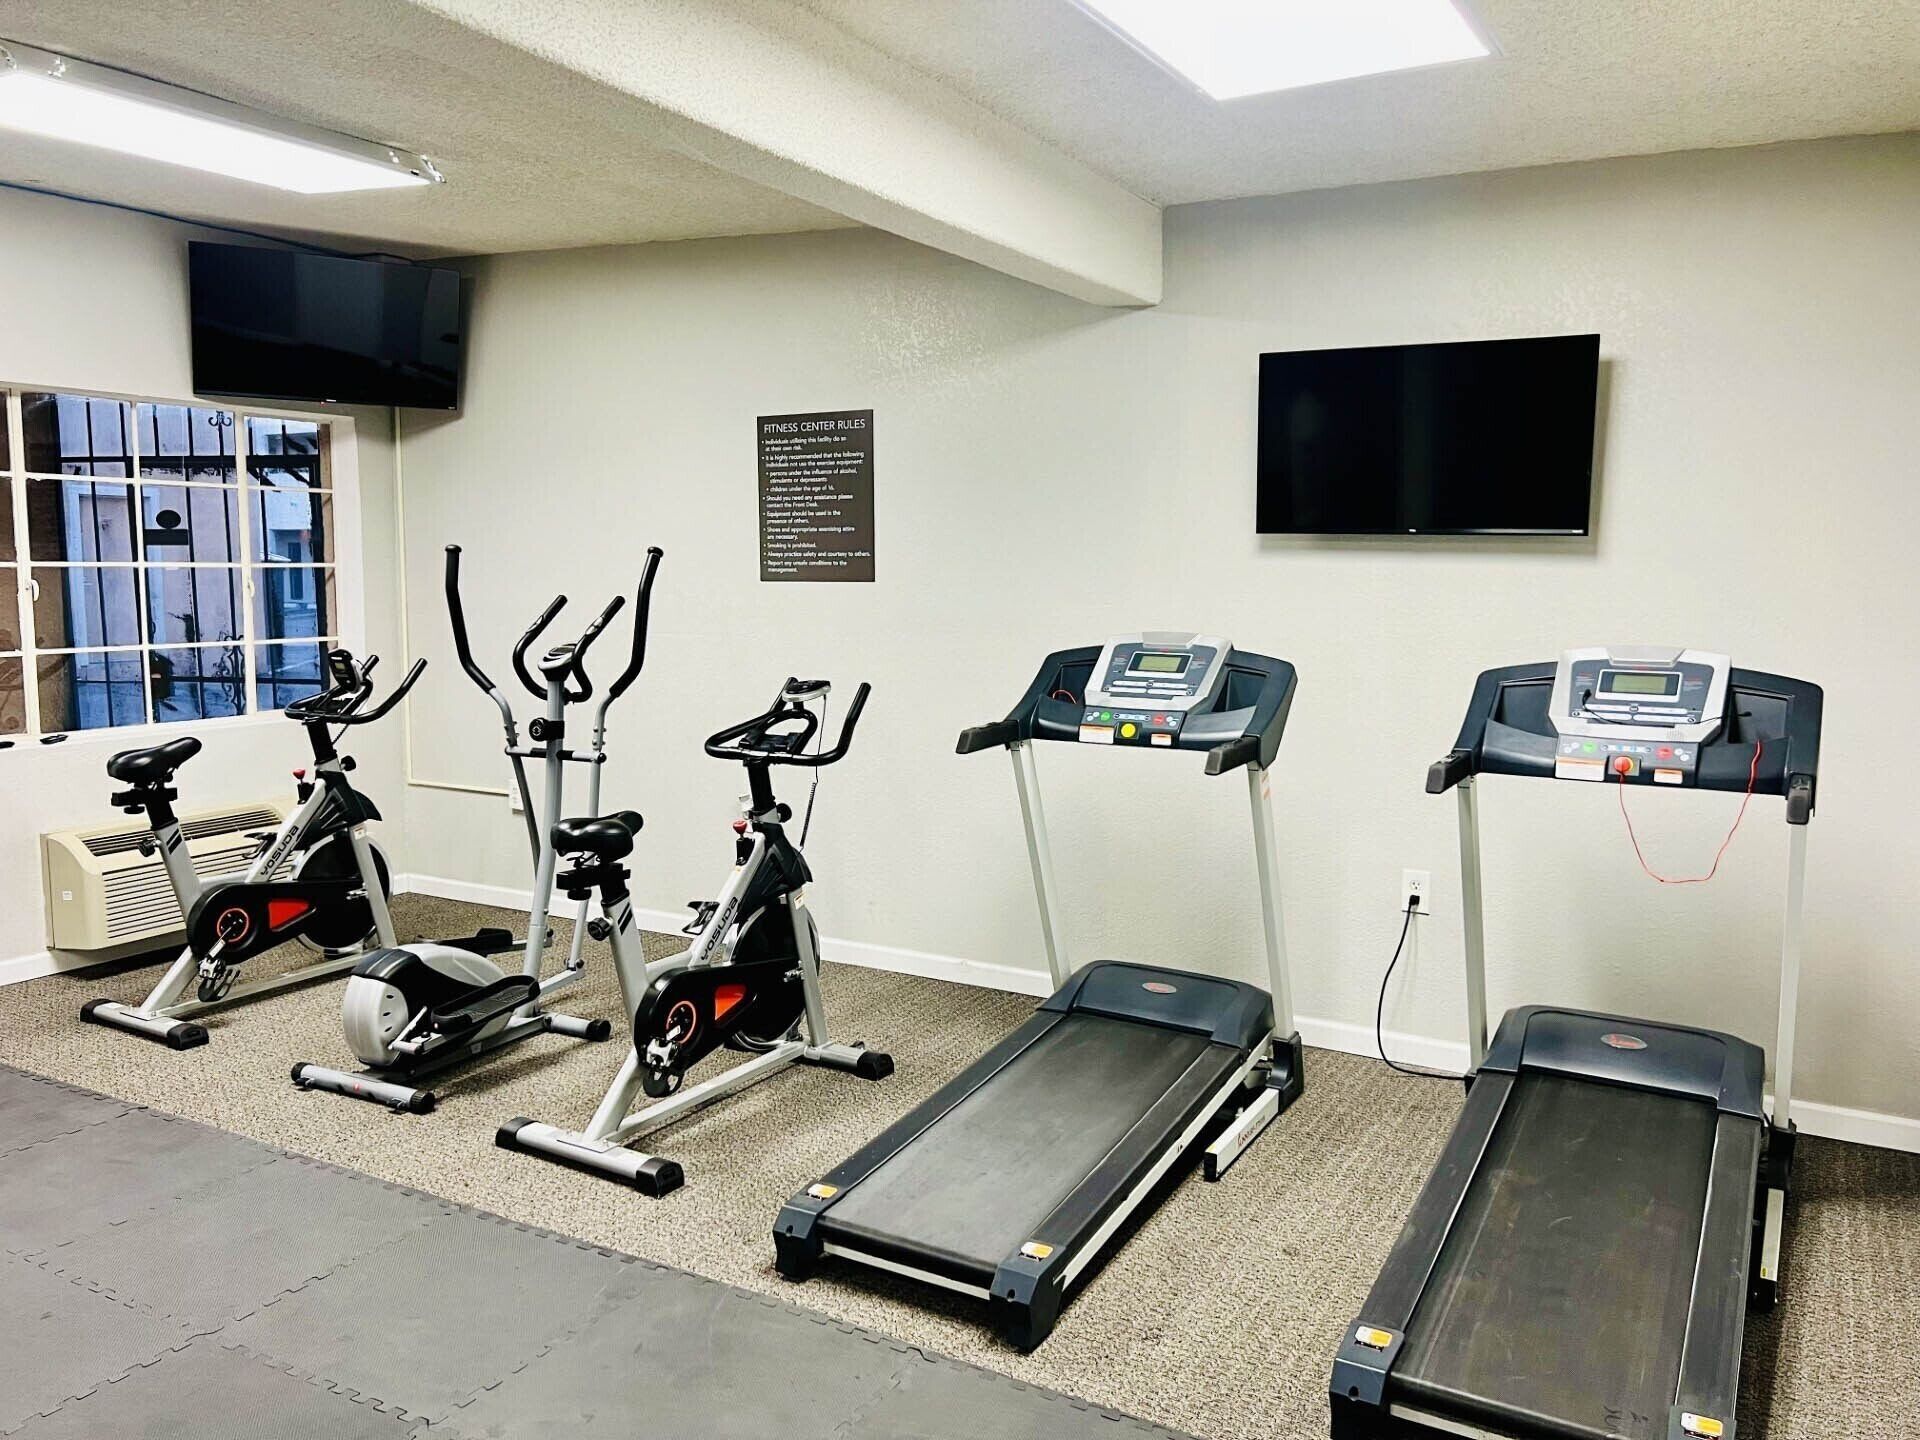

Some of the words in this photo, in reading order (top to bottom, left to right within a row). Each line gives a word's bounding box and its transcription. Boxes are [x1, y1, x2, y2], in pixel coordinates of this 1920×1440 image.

[764, 423, 798, 433] FITNESS
[801, 421, 834, 431] CENTER
[838, 419, 865, 429] RULES
[843, 451, 864, 459] following
